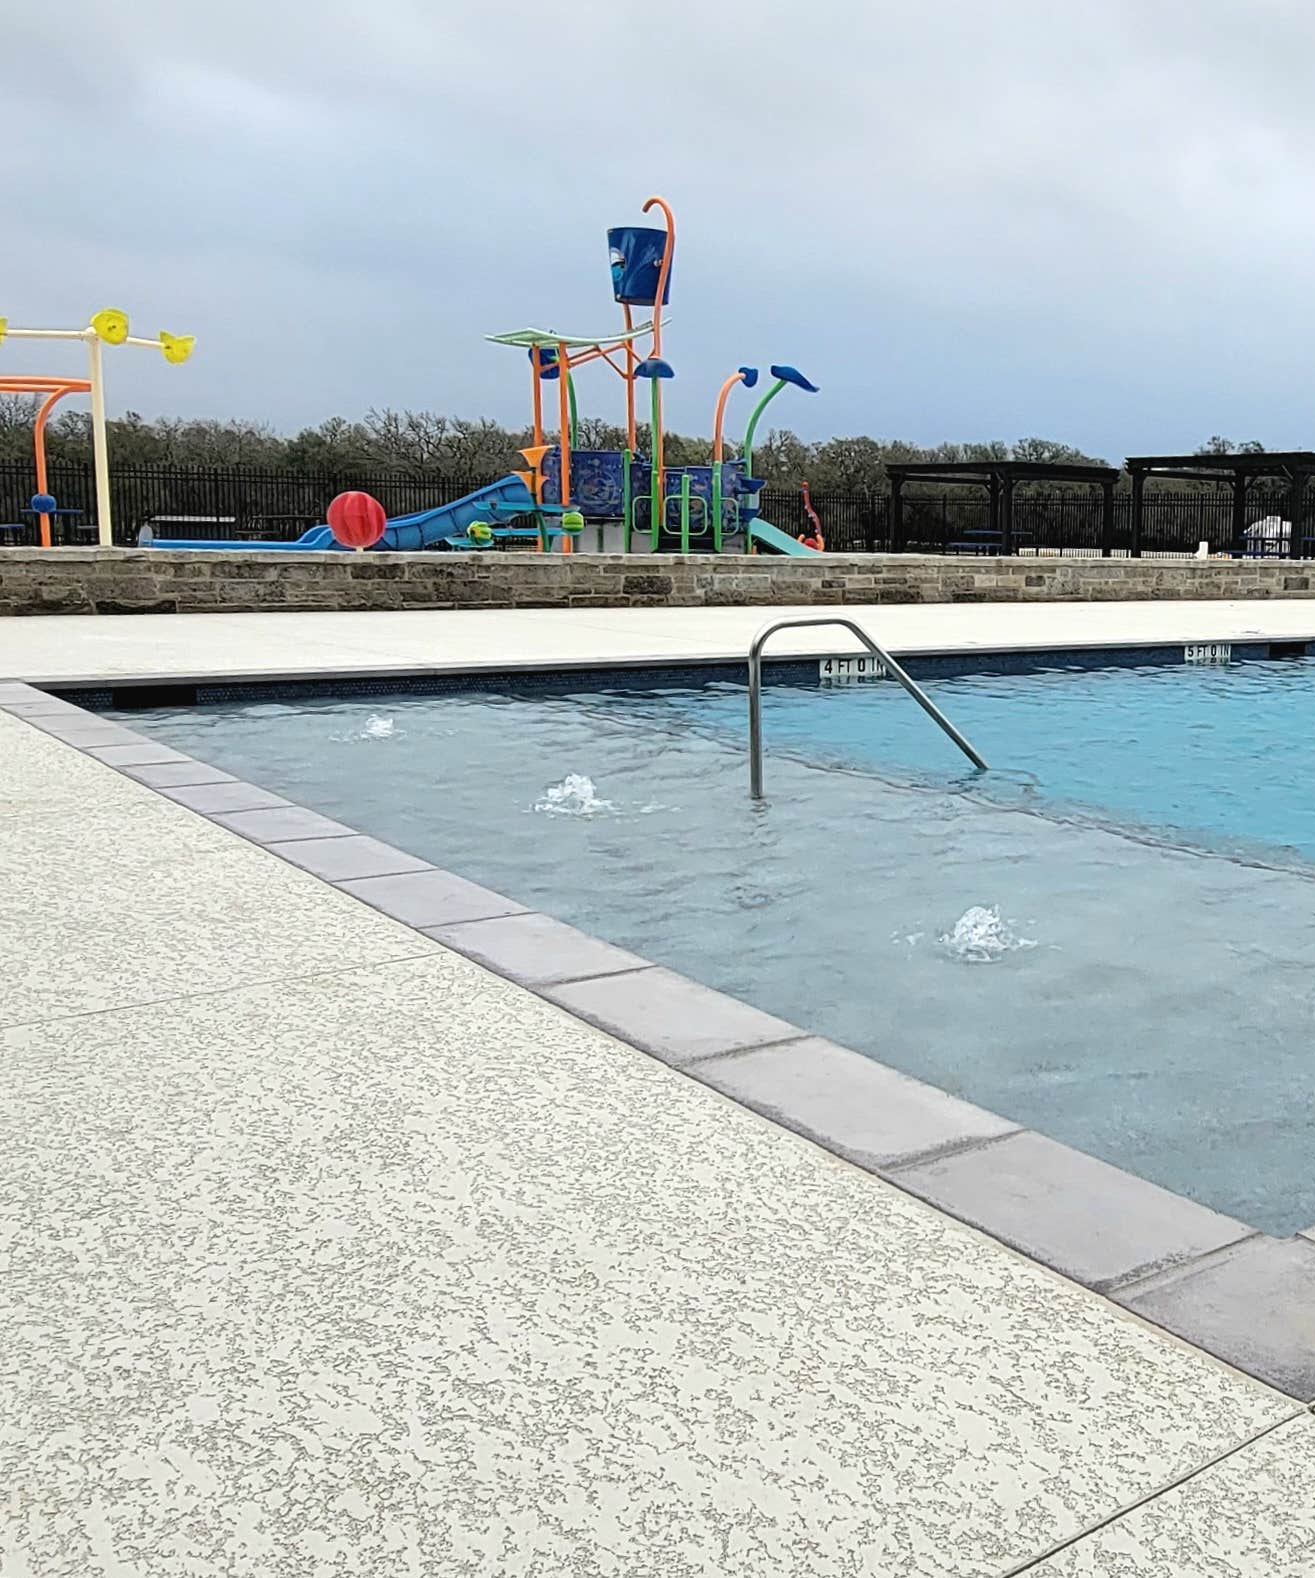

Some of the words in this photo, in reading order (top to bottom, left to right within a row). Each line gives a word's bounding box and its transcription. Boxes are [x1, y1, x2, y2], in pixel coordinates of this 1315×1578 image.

[1187, 645, 1194, 657] 5
[1197, 645, 1208, 657] FT
[1210, 644, 1217, 657] 0
[1220, 643, 1229, 657] IN
[824, 659, 833, 674] 4
[838, 659, 852, 674] FT
[857, 658, 866, 673] 0
[871, 657, 885, 675] IN
